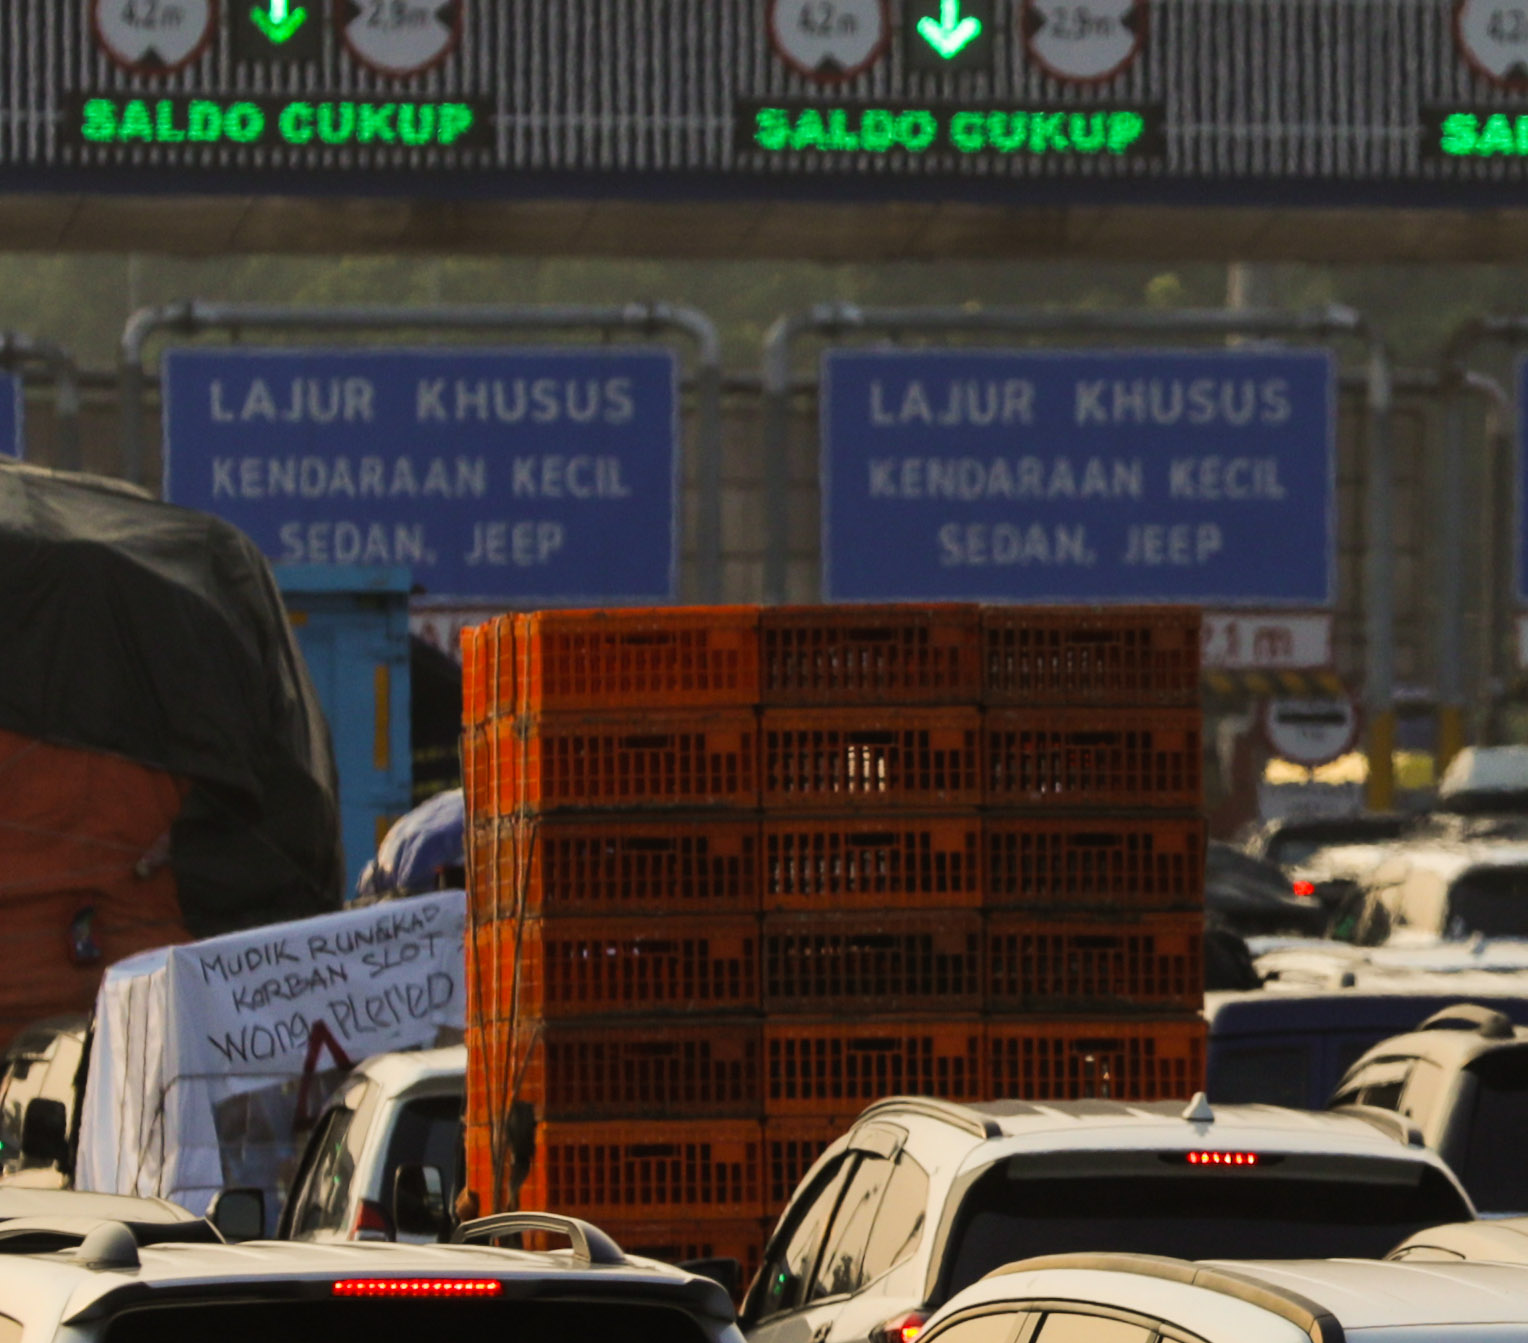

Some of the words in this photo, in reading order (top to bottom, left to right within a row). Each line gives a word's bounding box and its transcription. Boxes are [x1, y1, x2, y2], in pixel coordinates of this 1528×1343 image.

[81, 99, 265, 142] SALDO
[278, 102, 473, 145] CUKUP
[754, 108, 937, 152] SALDO
[950, 111, 1144, 155] CUKUP
[209, 377, 375, 424] LAJUR
[415, 377, 634, 425] KHUSUS
[870, 377, 1035, 426] LAJUR
[1075, 377, 1292, 424] KHUSUS
[210, 454, 487, 499] KENDARAAN
[511, 454, 632, 499] KECIL
[870, 456, 1142, 500] KENDARAAN
[1168, 456, 1286, 500] KECIL
[464, 520, 563, 566] JEEP
[1124, 521, 1223, 567] JEEP
[200, 937, 300, 986] MUDIK
[362, 932, 443, 978] SLOT
